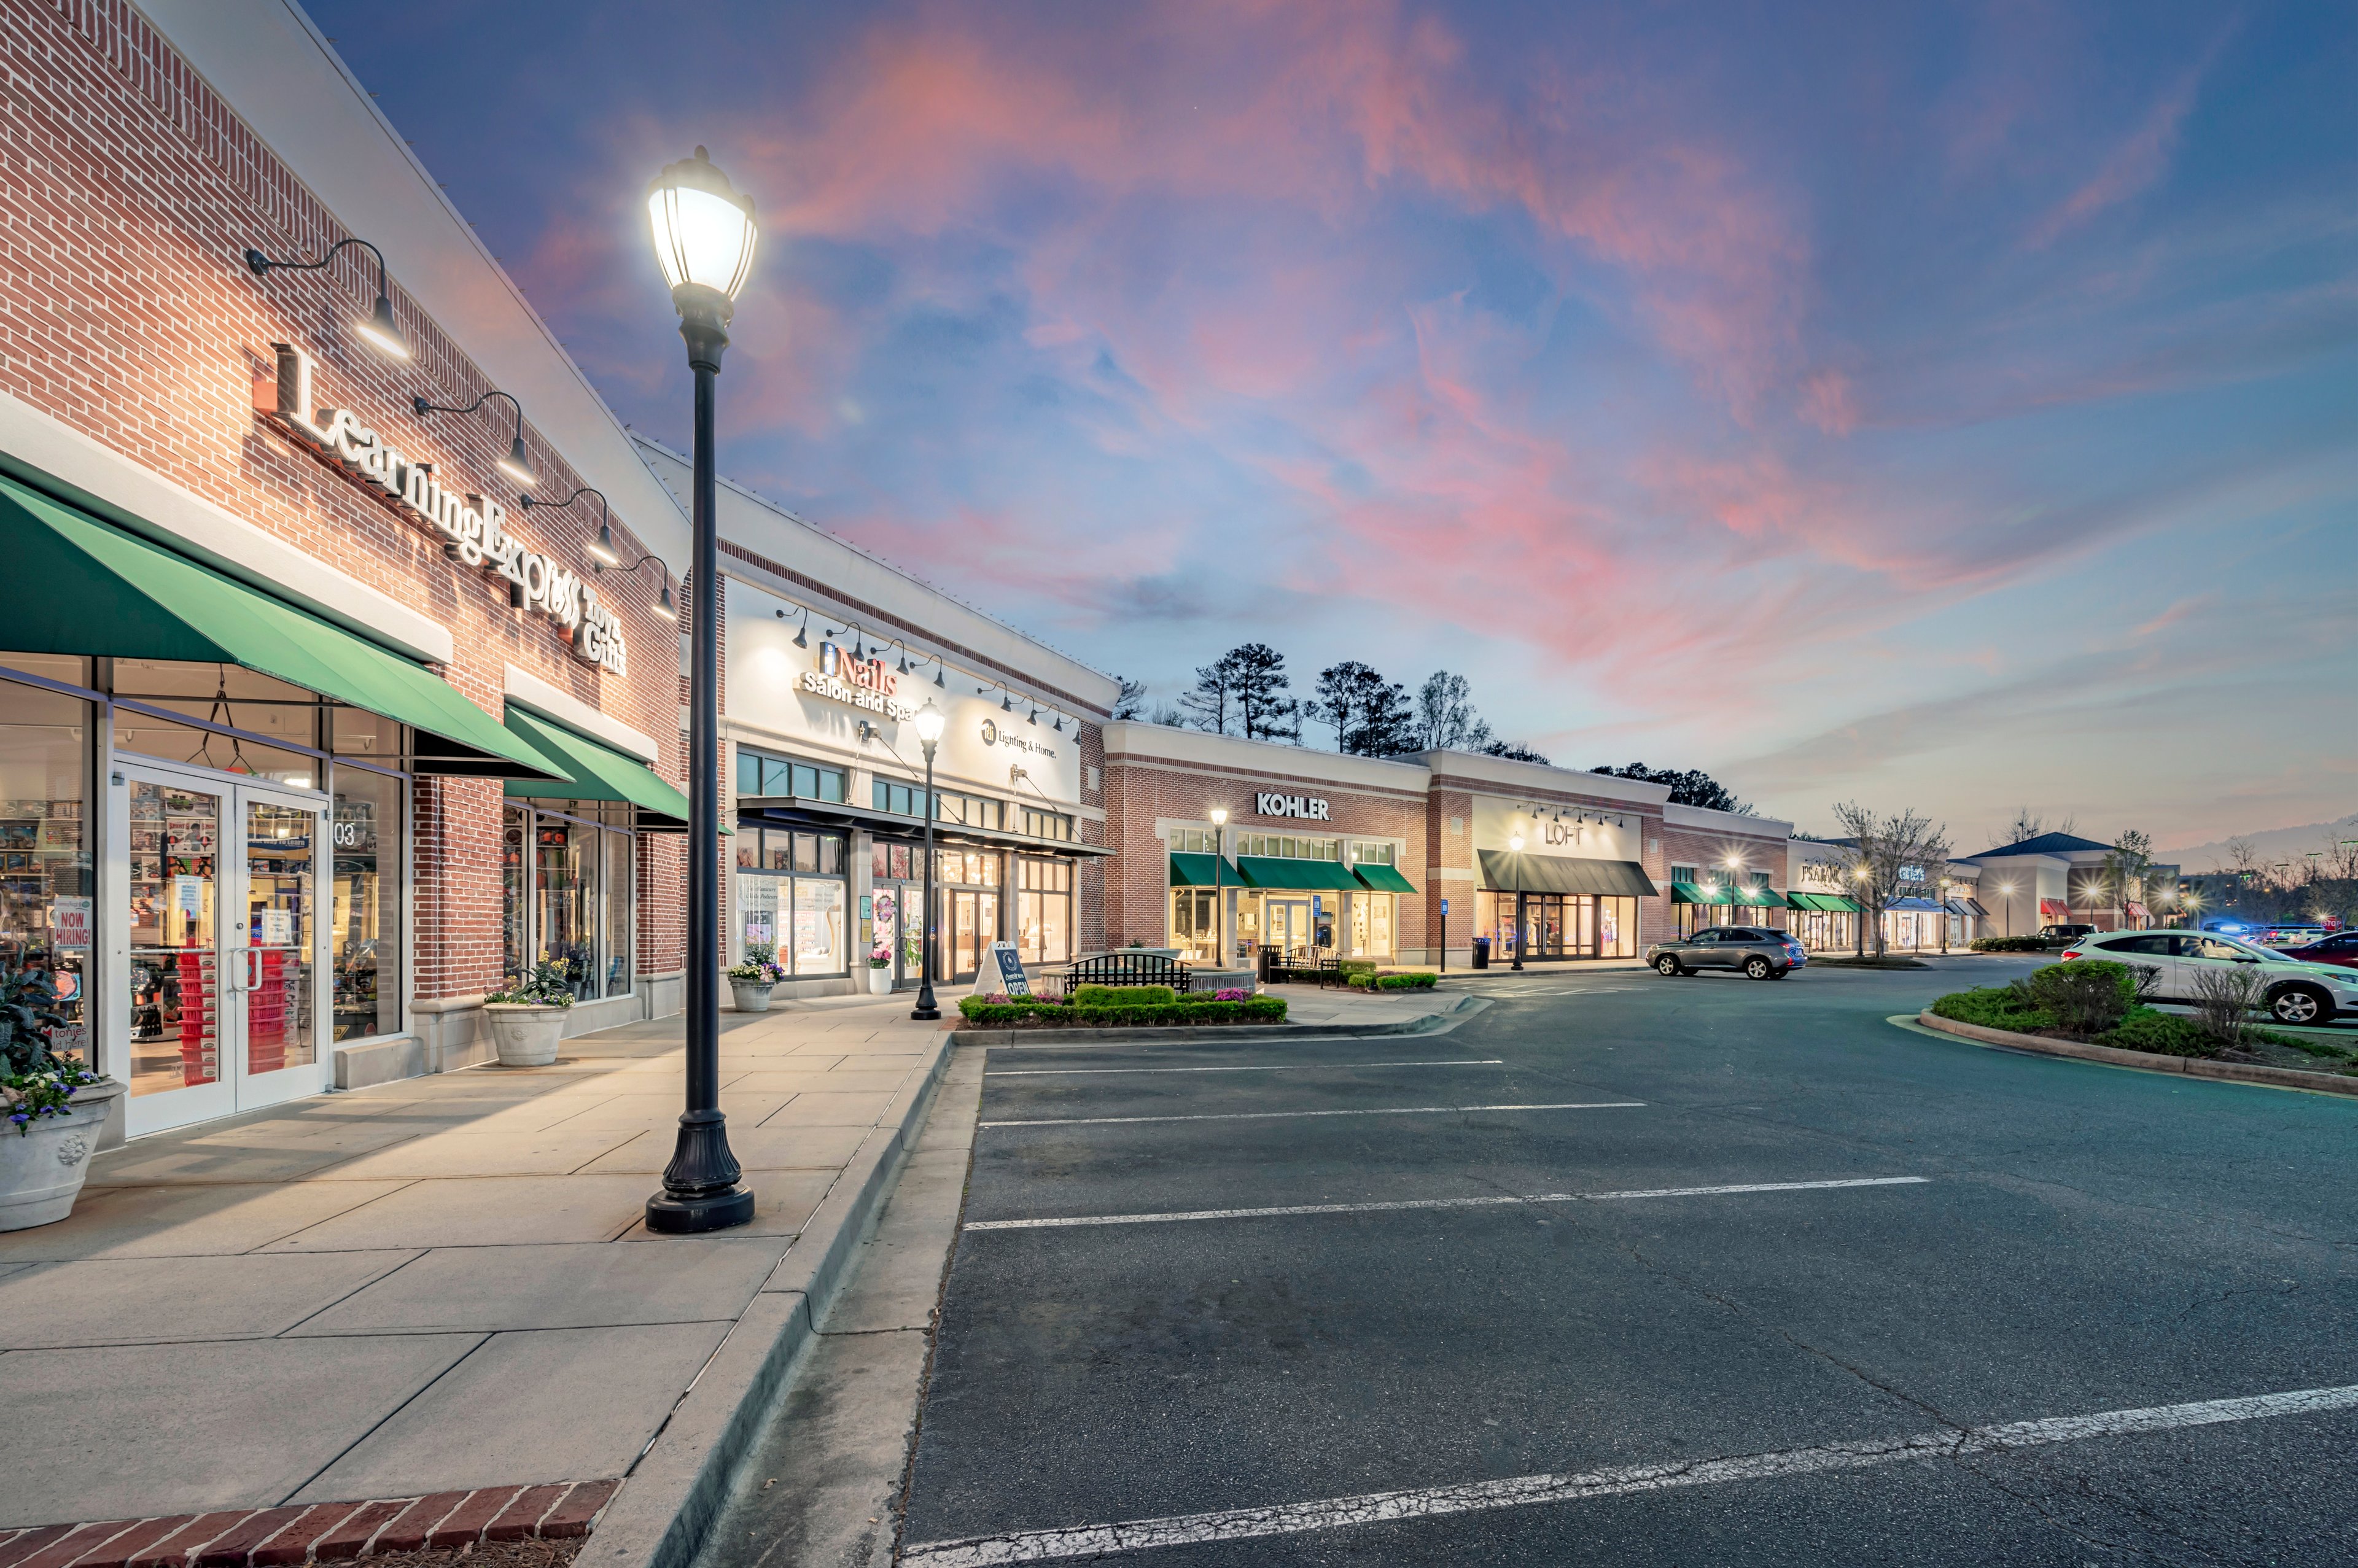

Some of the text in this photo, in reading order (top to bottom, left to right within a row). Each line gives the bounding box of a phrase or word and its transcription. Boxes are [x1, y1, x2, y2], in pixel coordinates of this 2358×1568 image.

[583, 584, 621, 643] Toys
[583, 621, 627, 678] Gifts
[805, 672, 914, 723] Salon and Spa
[998, 730, 1027, 753] Lighting
[1028, 740, 1034, 752] &
[1545, 823, 1584, 846] LOFT
[61, 912, 84, 928] NOW
[56, 928, 90, 945] HIRING!
[1008, 981, 1030, 995] OPEN
